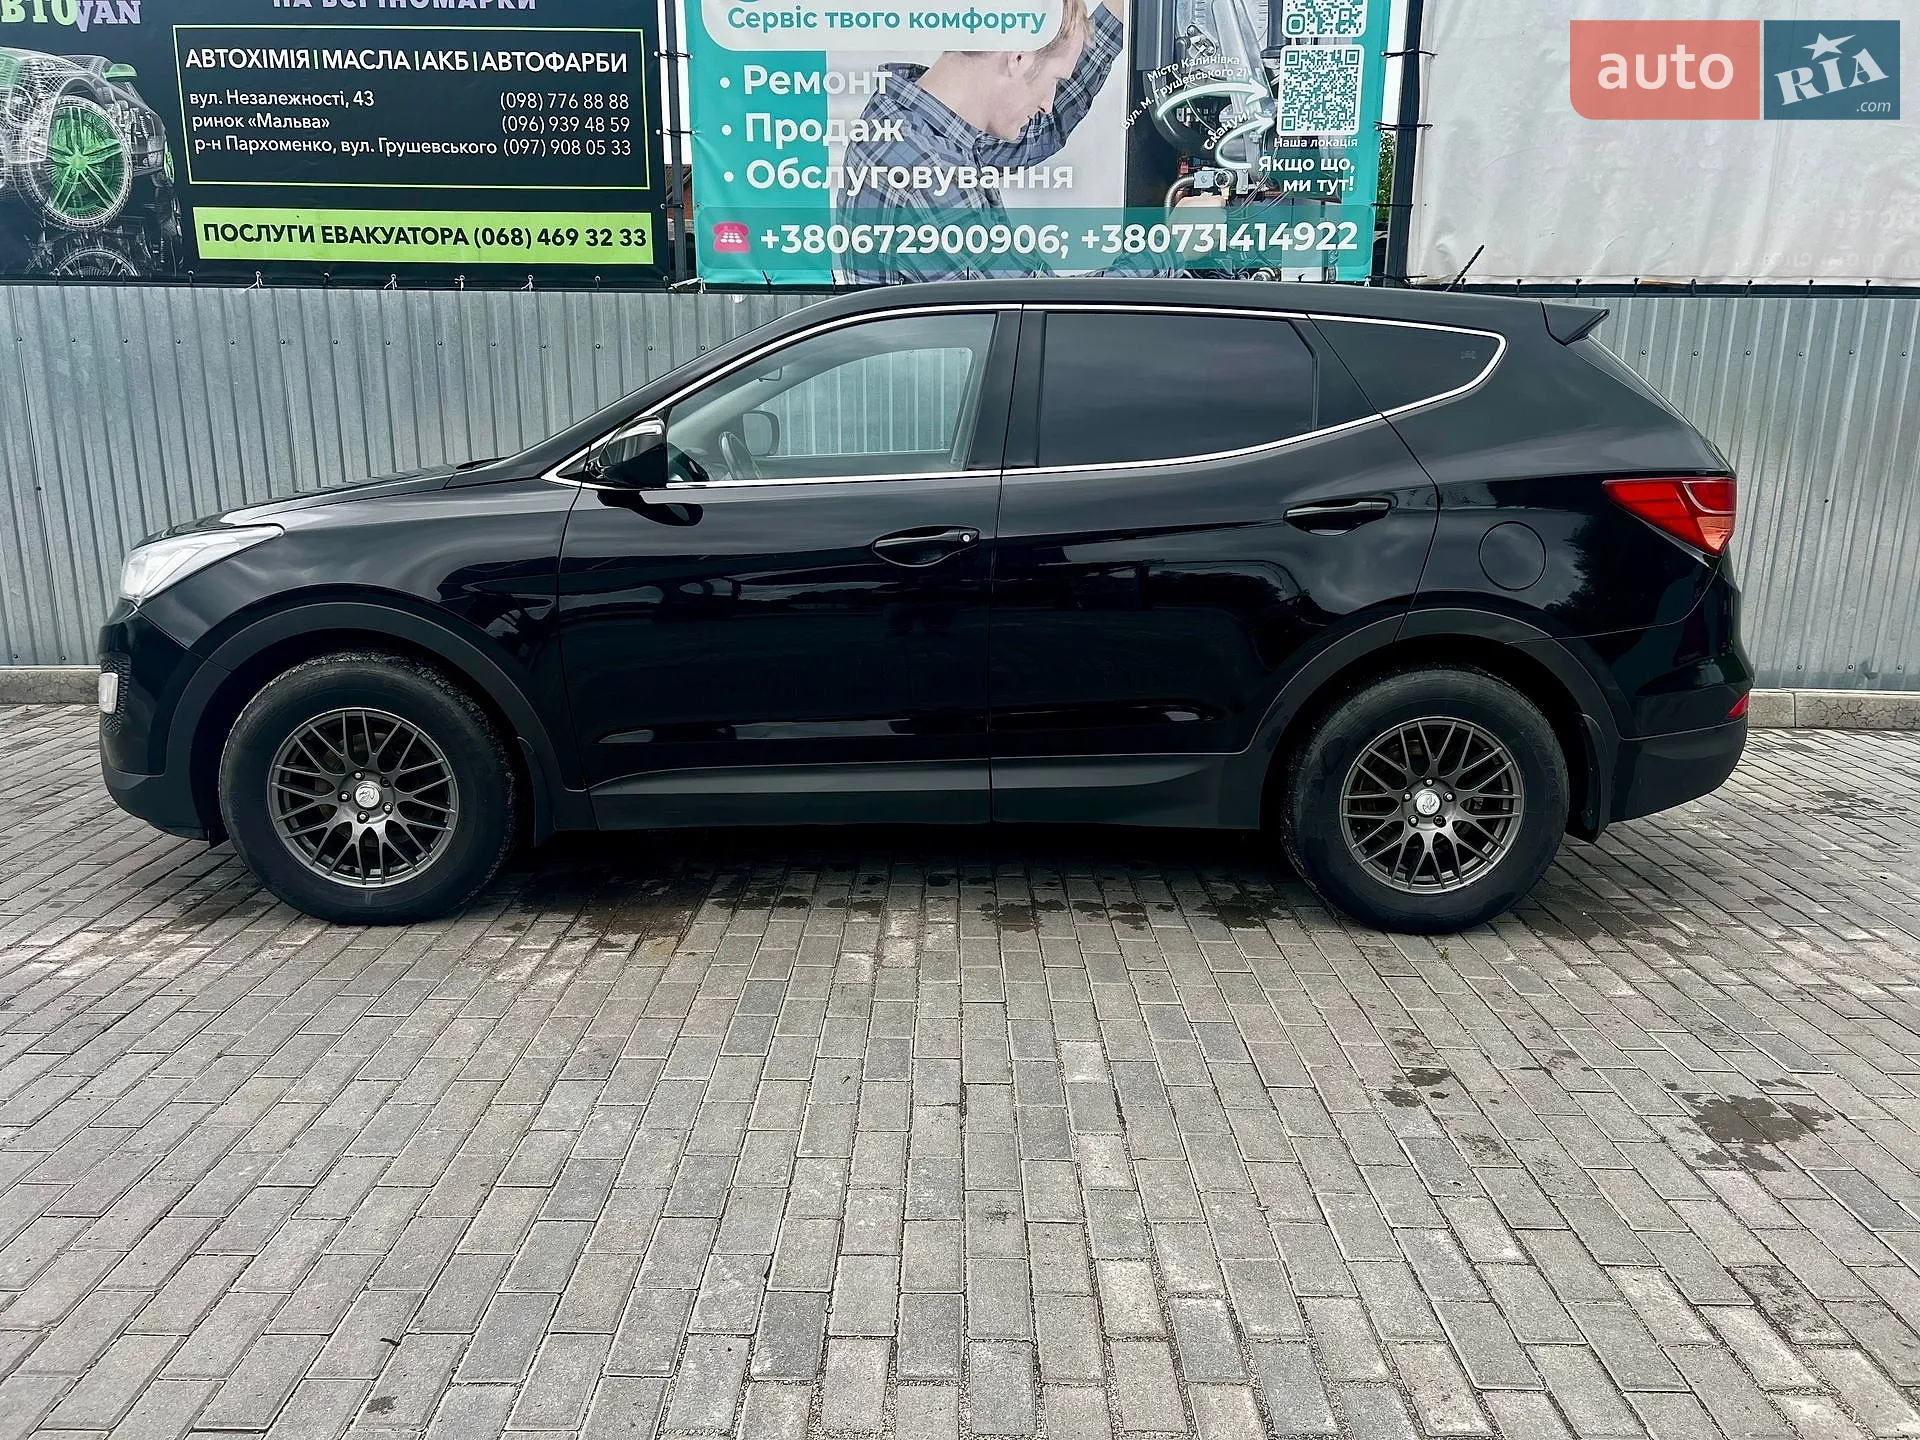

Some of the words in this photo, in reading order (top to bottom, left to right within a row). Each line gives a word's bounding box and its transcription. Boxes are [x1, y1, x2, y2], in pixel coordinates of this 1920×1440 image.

[727, 5, 818, 33] Сервіс
[825, 10, 901, 30] твого
[908, 8, 1047, 34] комфорту
[185, 48, 310, 69] АВТОХІМІЯ
[323, 49, 411, 71] МАСЛА
[422, 50, 469, 71] АКБ
[480, 51, 628, 73] АВТОФАРБИ
[1146, 62, 1179, 82] Місто
[1181, 54, 1240, 70] Калинівка
[743, 65, 893, 95] Ремонт
[1140, 95, 1155, 111] М.
[1153, 67, 1234, 100] Грушевського
[189, 91, 223, 108] вул.
[226, 89, 350, 108] Незалежності,
[352, 90, 375, 107] 43
[500, 92, 544, 111] (098)
[547, 93, 579, 109] 776
[583, 93, 604, 110] 88
[608, 93, 629, 110] 88
[192, 113, 244, 131] ринок
[247, 112, 331, 129] «Мальва»
[501, 115, 546, 135] (096)
[549, 116, 580, 132] 939
[584, 116, 605, 133] 48
[610, 117, 631, 133] 59
[745, 113, 905, 149] Продаж
[194, 138, 222, 154] р-н
[226, 135, 337, 155] Пархоменко,
[341, 142, 375, 157] вул.
[378, 137, 498, 158] Грушевського
[503, 138, 546, 157] (097)
[550, 139, 581, 155] 908
[586, 139, 606, 156] 05
[611, 140, 631, 156] 33
[1274, 137, 1307, 148] Наша
[1309, 136, 1358, 149] локація
[746, 157, 1073, 196] Обслуговування
[1258, 155, 1315, 173] Якщо
[1320, 157, 1355, 174] що,
[1283, 179, 1311, 192] ми
[1317, 176, 1355, 195] тут!
[203, 223, 316, 243] ПОСЛУГИ
[321, 226, 470, 246] ЕВАКУАТОРА
[474, 227, 532, 250] (068)
[537, 228, 579, 246] 469
[585, 228, 613, 247] 32
[619, 228, 647, 246] 33
[760, 223, 1070, 259] +380672900906;
[1081, 222, 1358, 254] +380731414922
